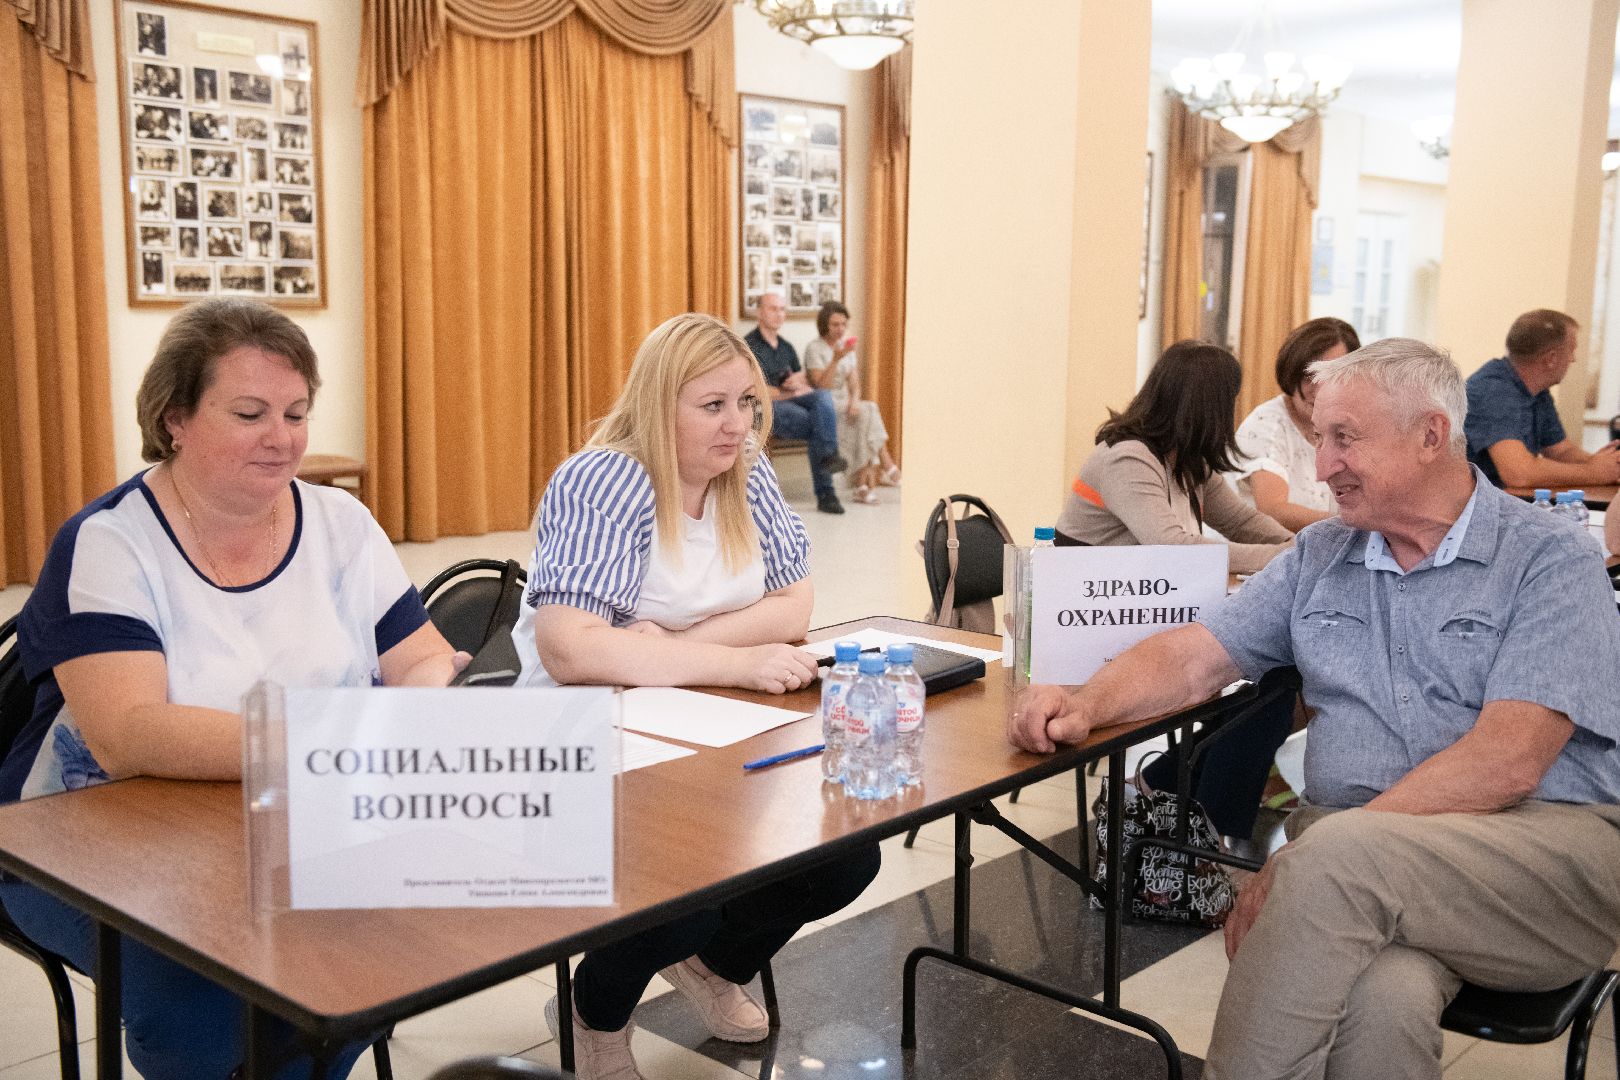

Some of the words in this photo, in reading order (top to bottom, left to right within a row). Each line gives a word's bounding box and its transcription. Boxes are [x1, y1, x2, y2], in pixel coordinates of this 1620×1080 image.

[1082, 578, 1178, 600] ЗДРАВО-
[1057, 606, 1200, 627] ОХРАНЕНИЕ
[305, 746, 596, 779] СОЦИАЛЬНЫЕ
[352, 792, 552, 821] ВОПРОСЫ
